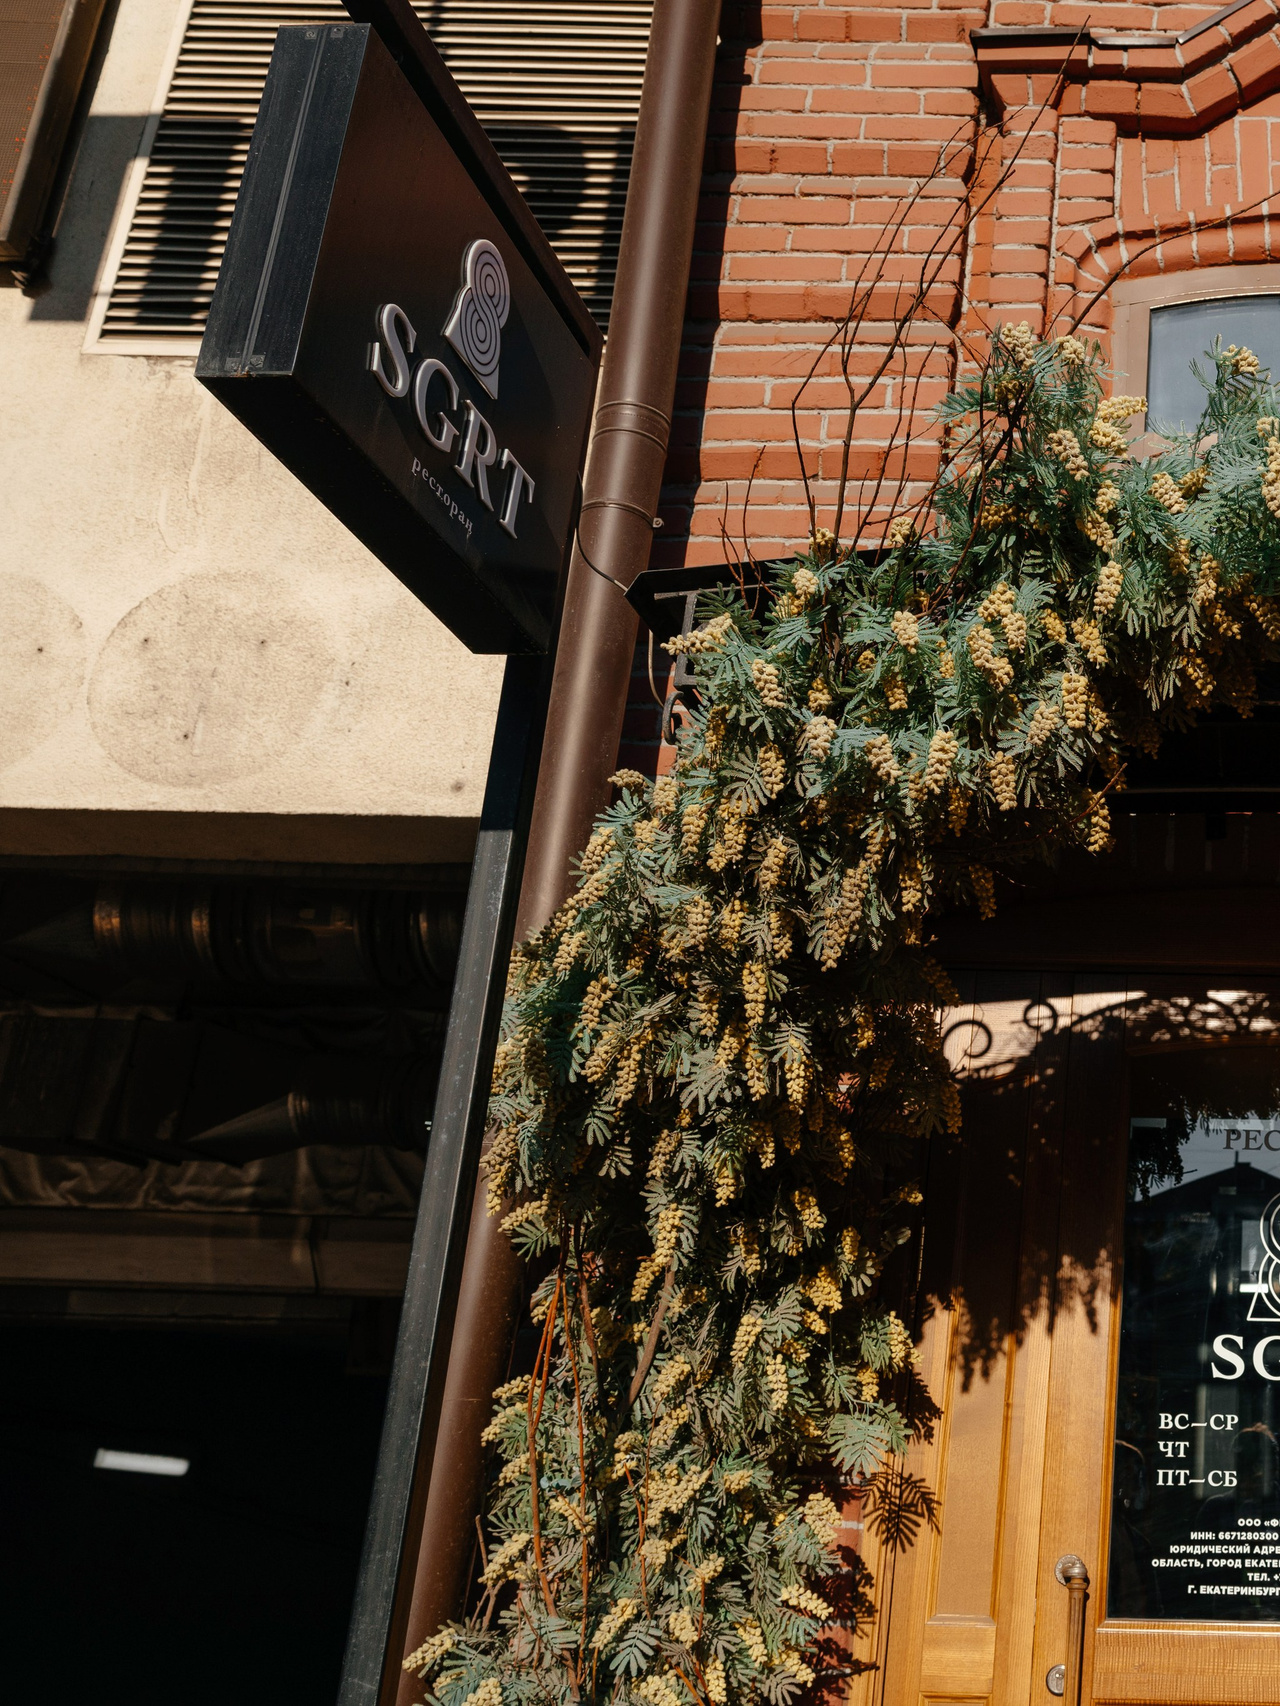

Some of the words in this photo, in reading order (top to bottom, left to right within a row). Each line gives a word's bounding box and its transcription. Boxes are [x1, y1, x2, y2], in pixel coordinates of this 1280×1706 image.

[366, 303, 536, 539] SGRT
[410, 456, 473, 532] ресторан
[1157, 1441, 1190, 1458] ЧТ
[1237, 1518, 1262, 1527] ООО
[1190, 1531, 1216, 1540] ИНН:
[1218, 1531, 1280, 1541] 6671280300
[1169, 1543, 1251, 1555] ЮРИДИЧЕСКИЙ
[1151, 1558, 1204, 1569] ОБЛАСТЬ,
[1206, 1558, 1243, 1569] ГОРОД
[1246, 1572, 1271, 1582] ТЕЛ.
[1187, 1584, 1198, 1594] Г.
